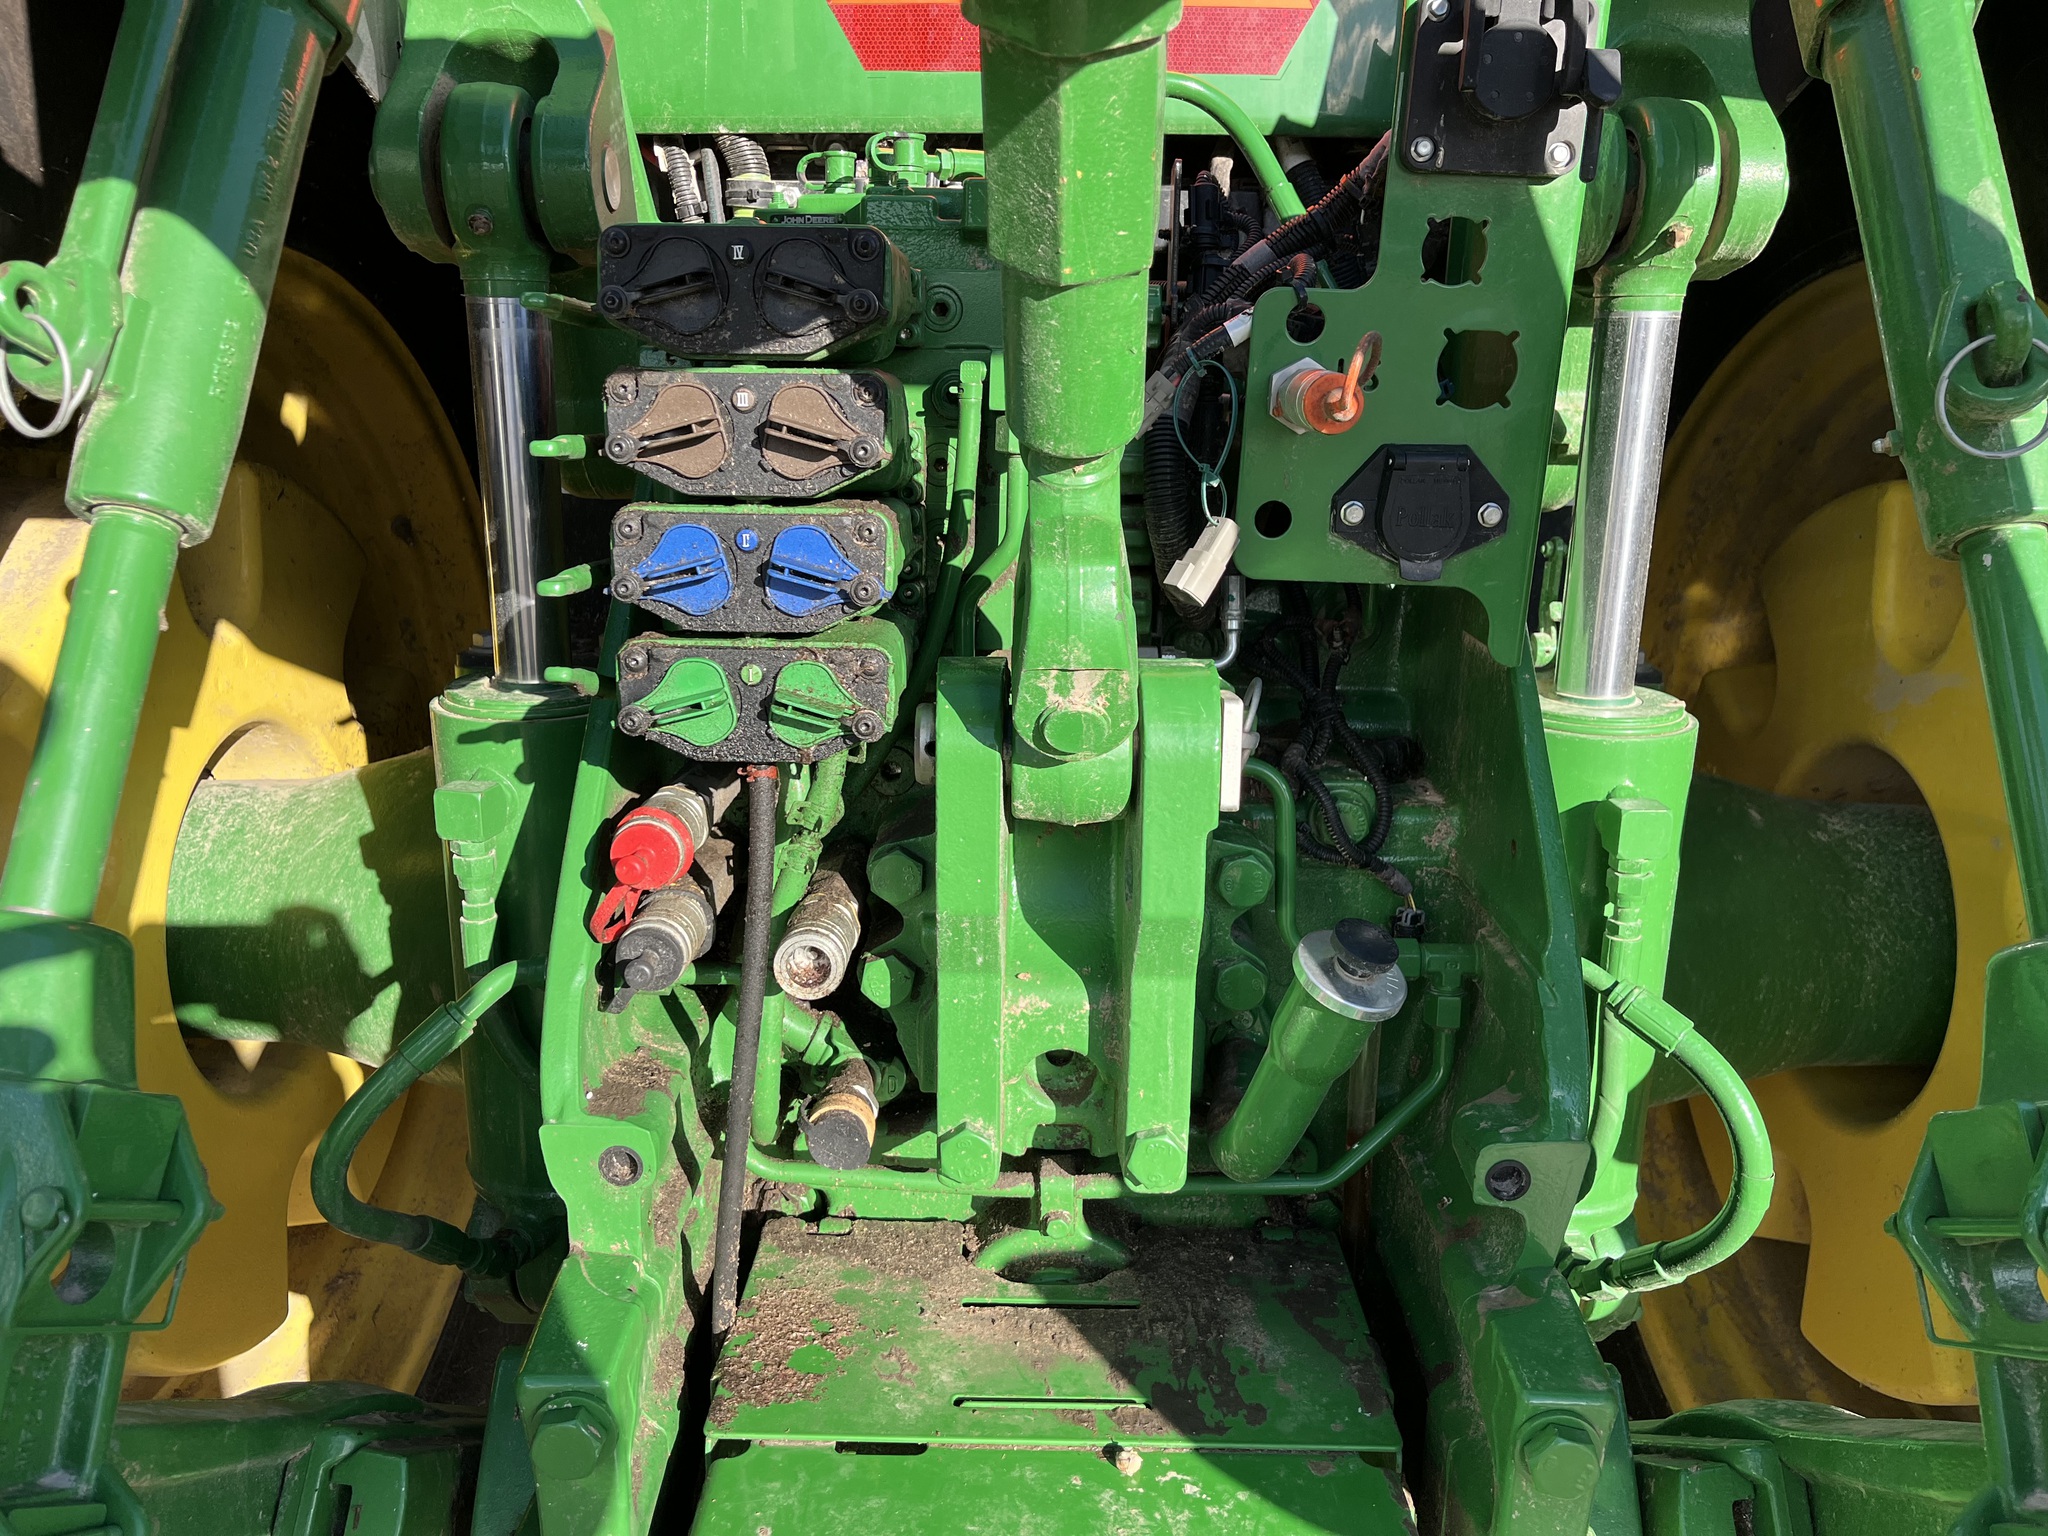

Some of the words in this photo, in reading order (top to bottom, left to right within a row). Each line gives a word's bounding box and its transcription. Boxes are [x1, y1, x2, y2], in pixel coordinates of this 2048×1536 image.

[780, 214, 803, 225] JOHN
[804, 214, 835, 225] DEERE
[731, 245, 744, 260] IV
[736, 392, 749, 407] III
[1395, 507, 1455, 529] Pollak
[748, 668, 753, 682] I
